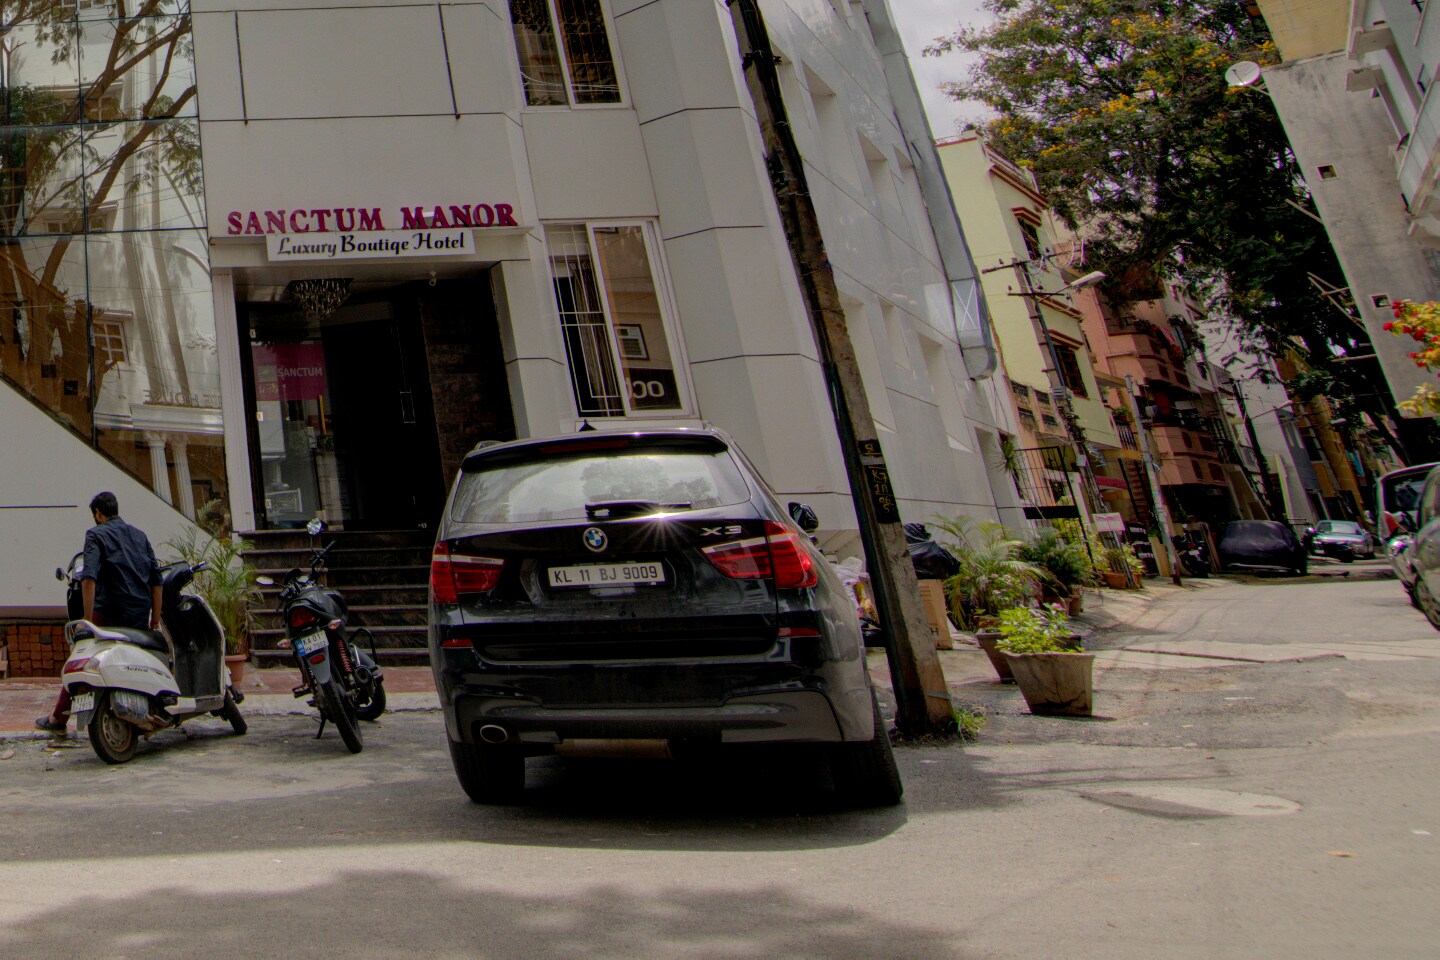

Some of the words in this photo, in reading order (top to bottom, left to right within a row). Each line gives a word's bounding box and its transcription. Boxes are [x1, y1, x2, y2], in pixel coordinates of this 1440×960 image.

[227, 207, 385, 235] SANCTUM
[400, 203, 519, 230] MANOR
[277, 237, 337, 258] Luxury
[340, 234, 410, 255] Boutiqe
[412, 231, 465, 250] Hotel
[277, 367, 323, 377] SANCTUM
[700, 525, 742, 536] X3
[554, 570, 572, 583] KL
[579, 569, 590, 582] 11
[600, 567, 617, 581] BJ
[623, 565, 658, 580] 9009
